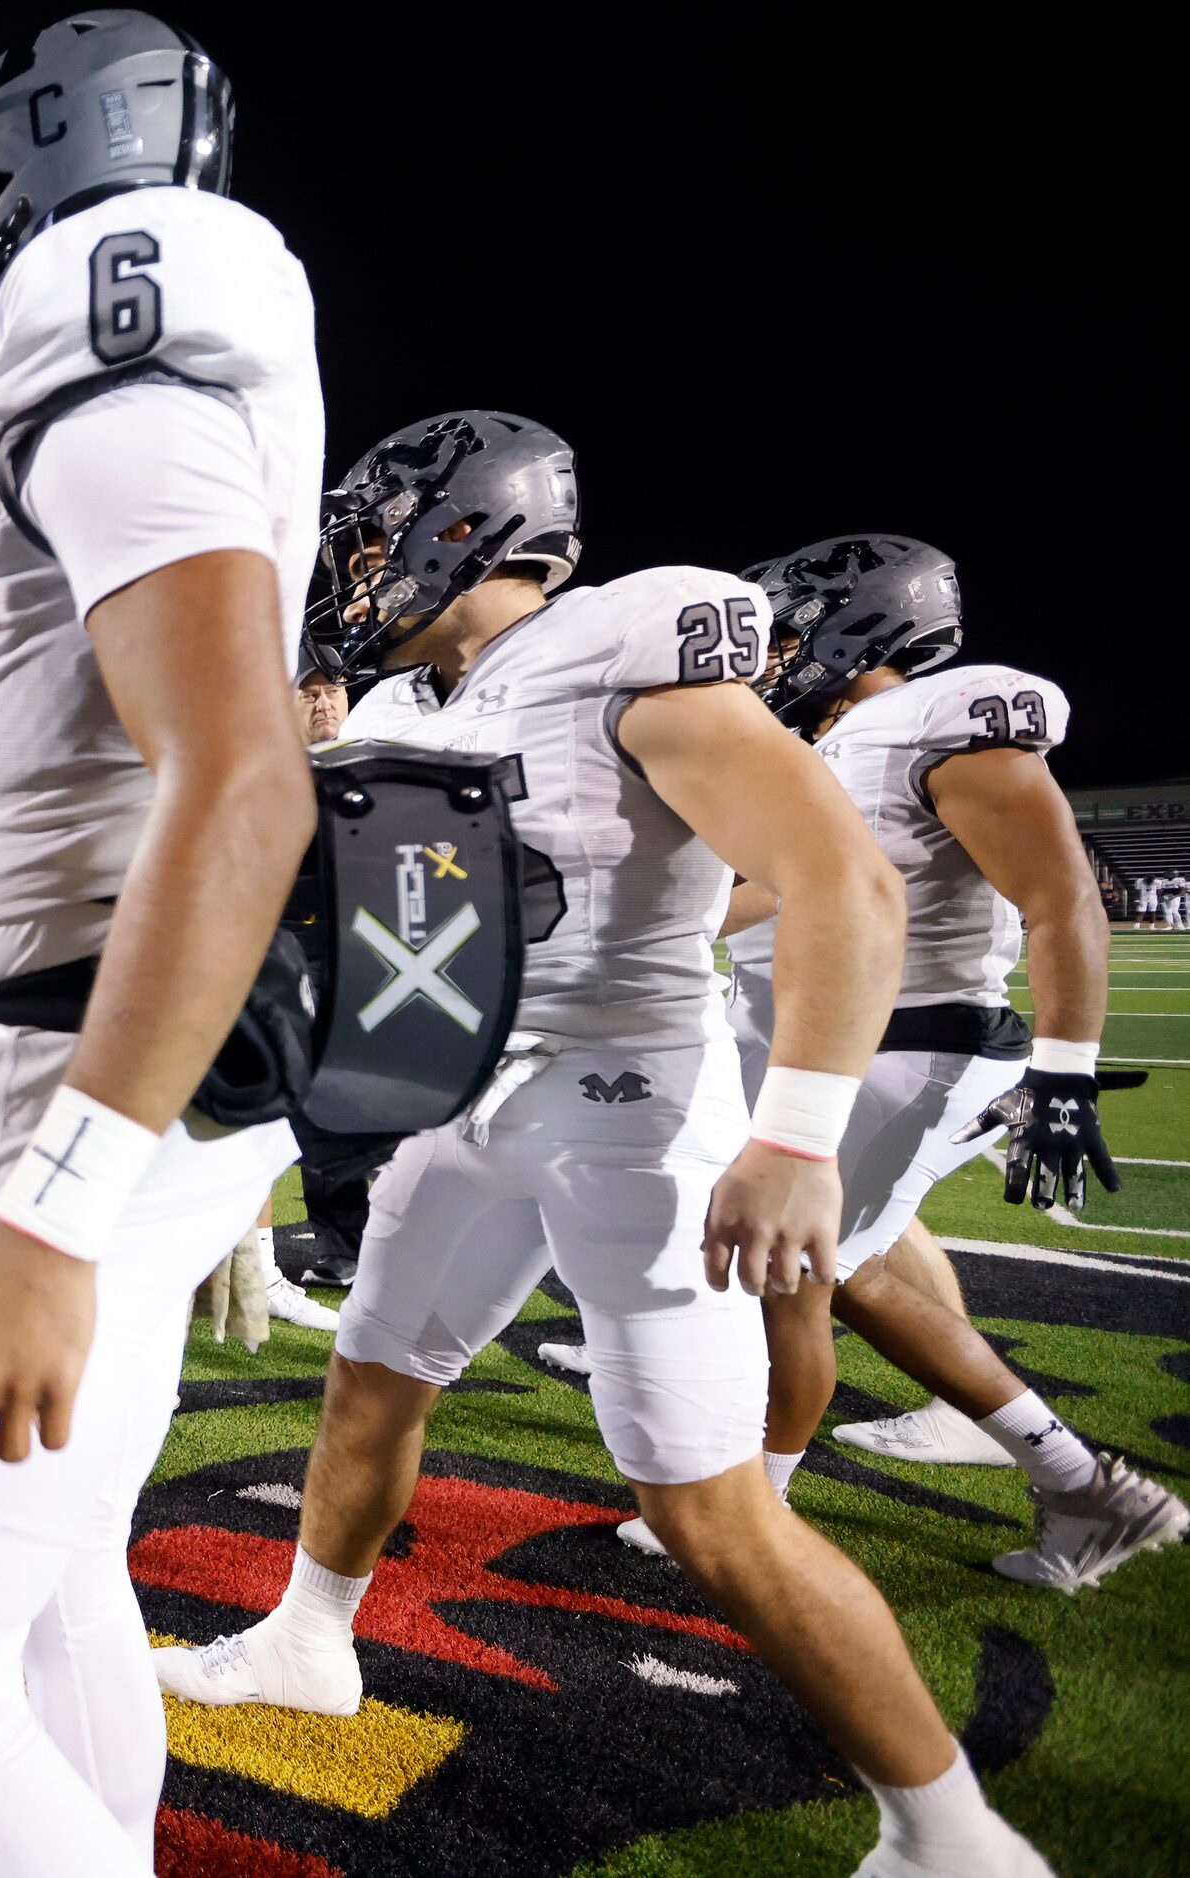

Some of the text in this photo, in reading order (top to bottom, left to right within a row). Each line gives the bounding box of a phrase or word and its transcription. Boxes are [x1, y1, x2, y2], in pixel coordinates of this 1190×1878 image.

[28, 81, 68, 148] C
[88, 229, 164, 367] 6
[675, 597, 760, 685] 25
[968, 690, 1047, 748] 33
[578, 1071, 653, 1104] M
